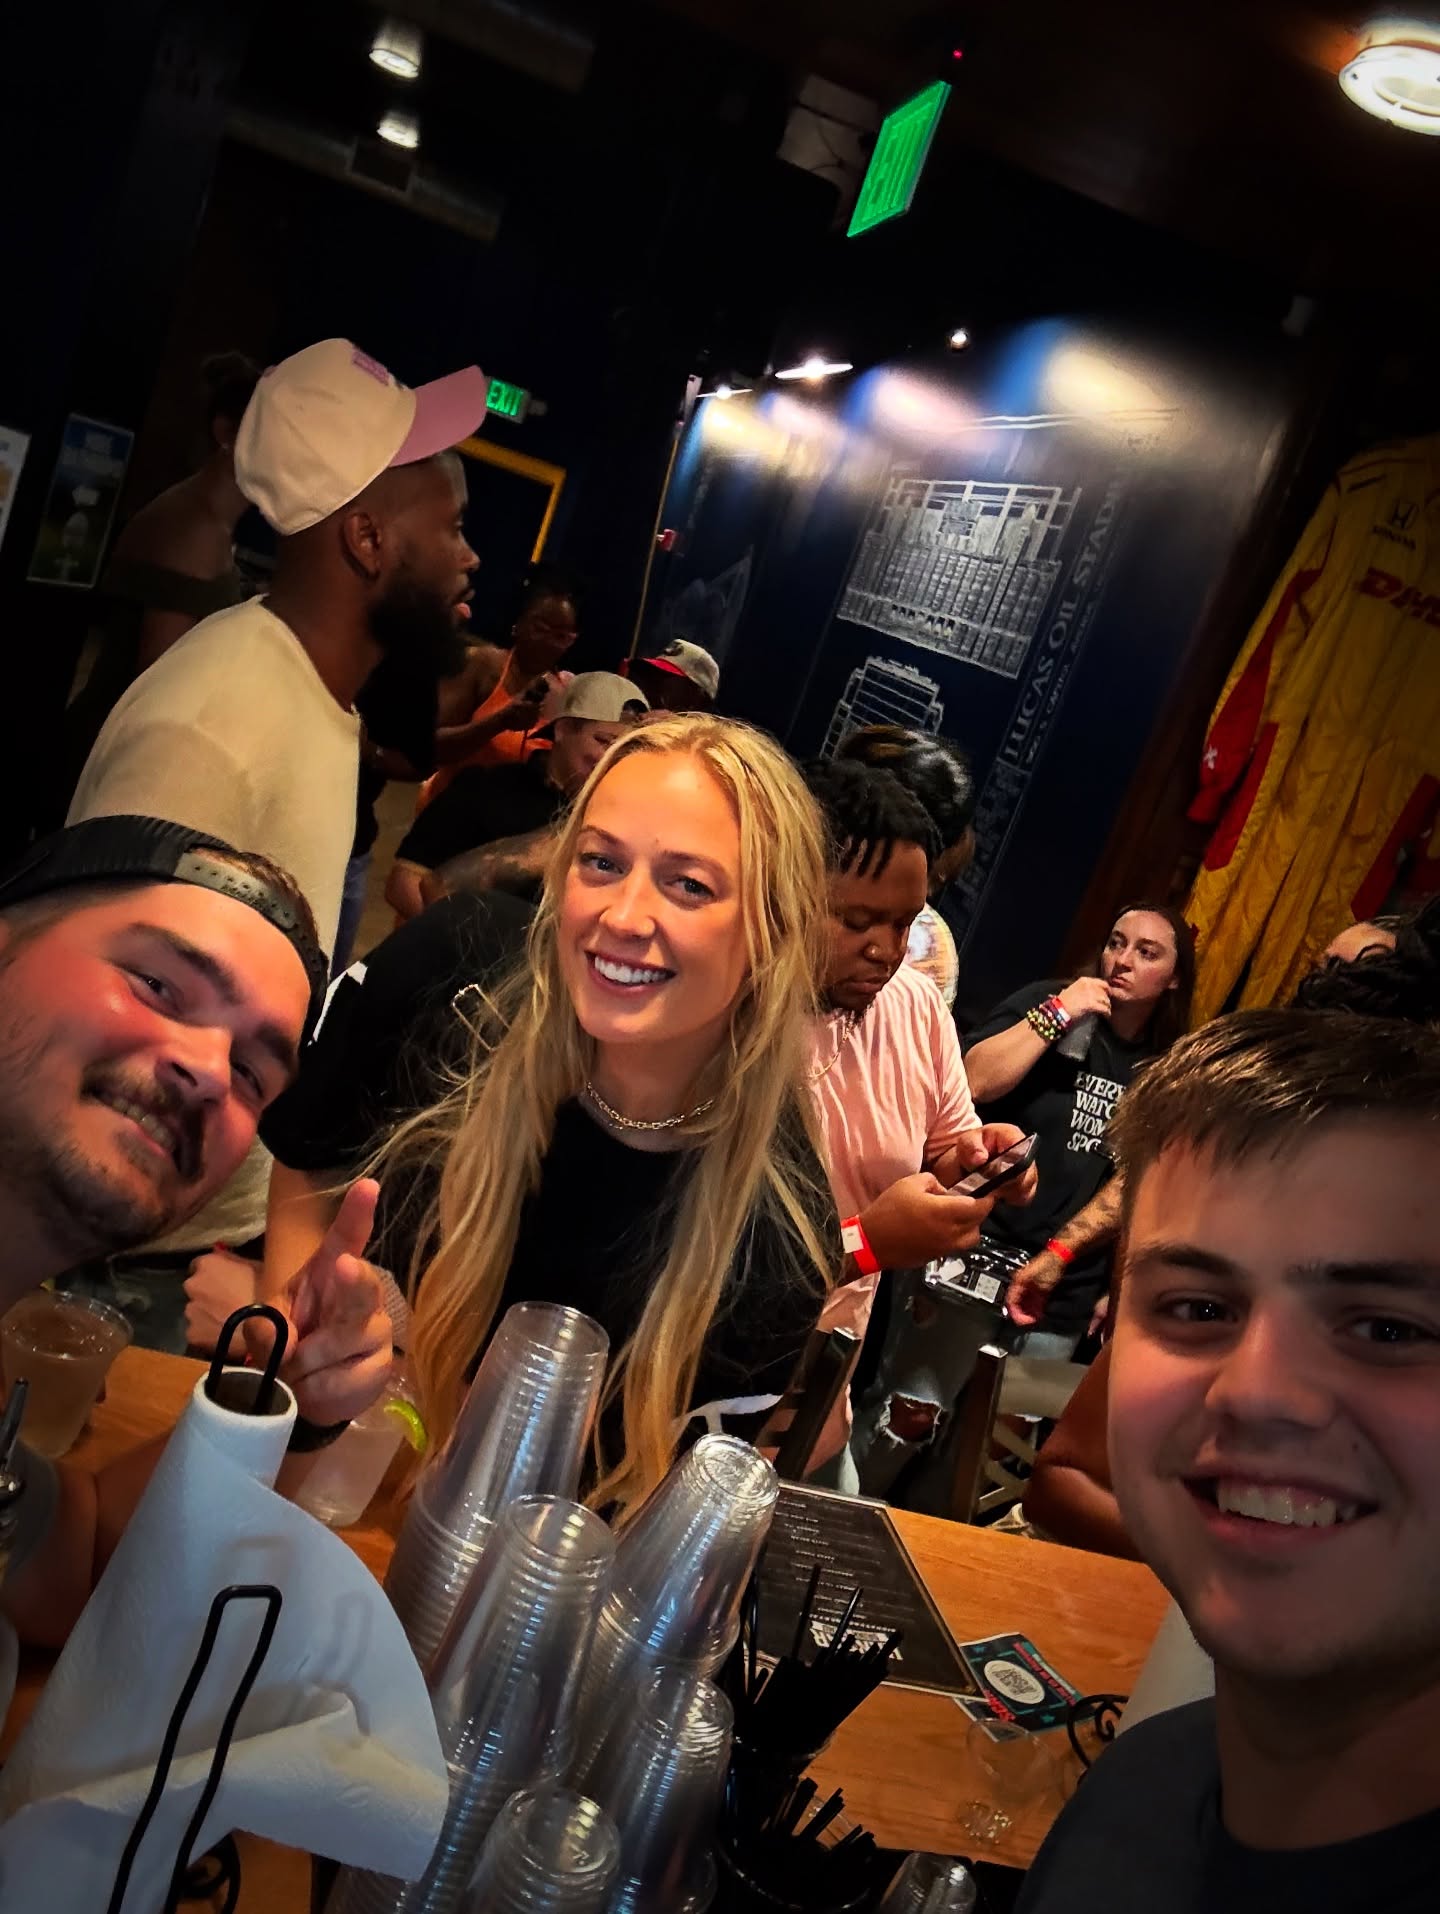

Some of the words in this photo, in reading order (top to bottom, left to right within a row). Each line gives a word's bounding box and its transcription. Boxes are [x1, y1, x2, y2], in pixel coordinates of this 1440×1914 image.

[486, 379, 525, 416] EXIT
[1003, 654, 1055, 761] LUCAS
[1049, 597, 1080, 650] OIL
